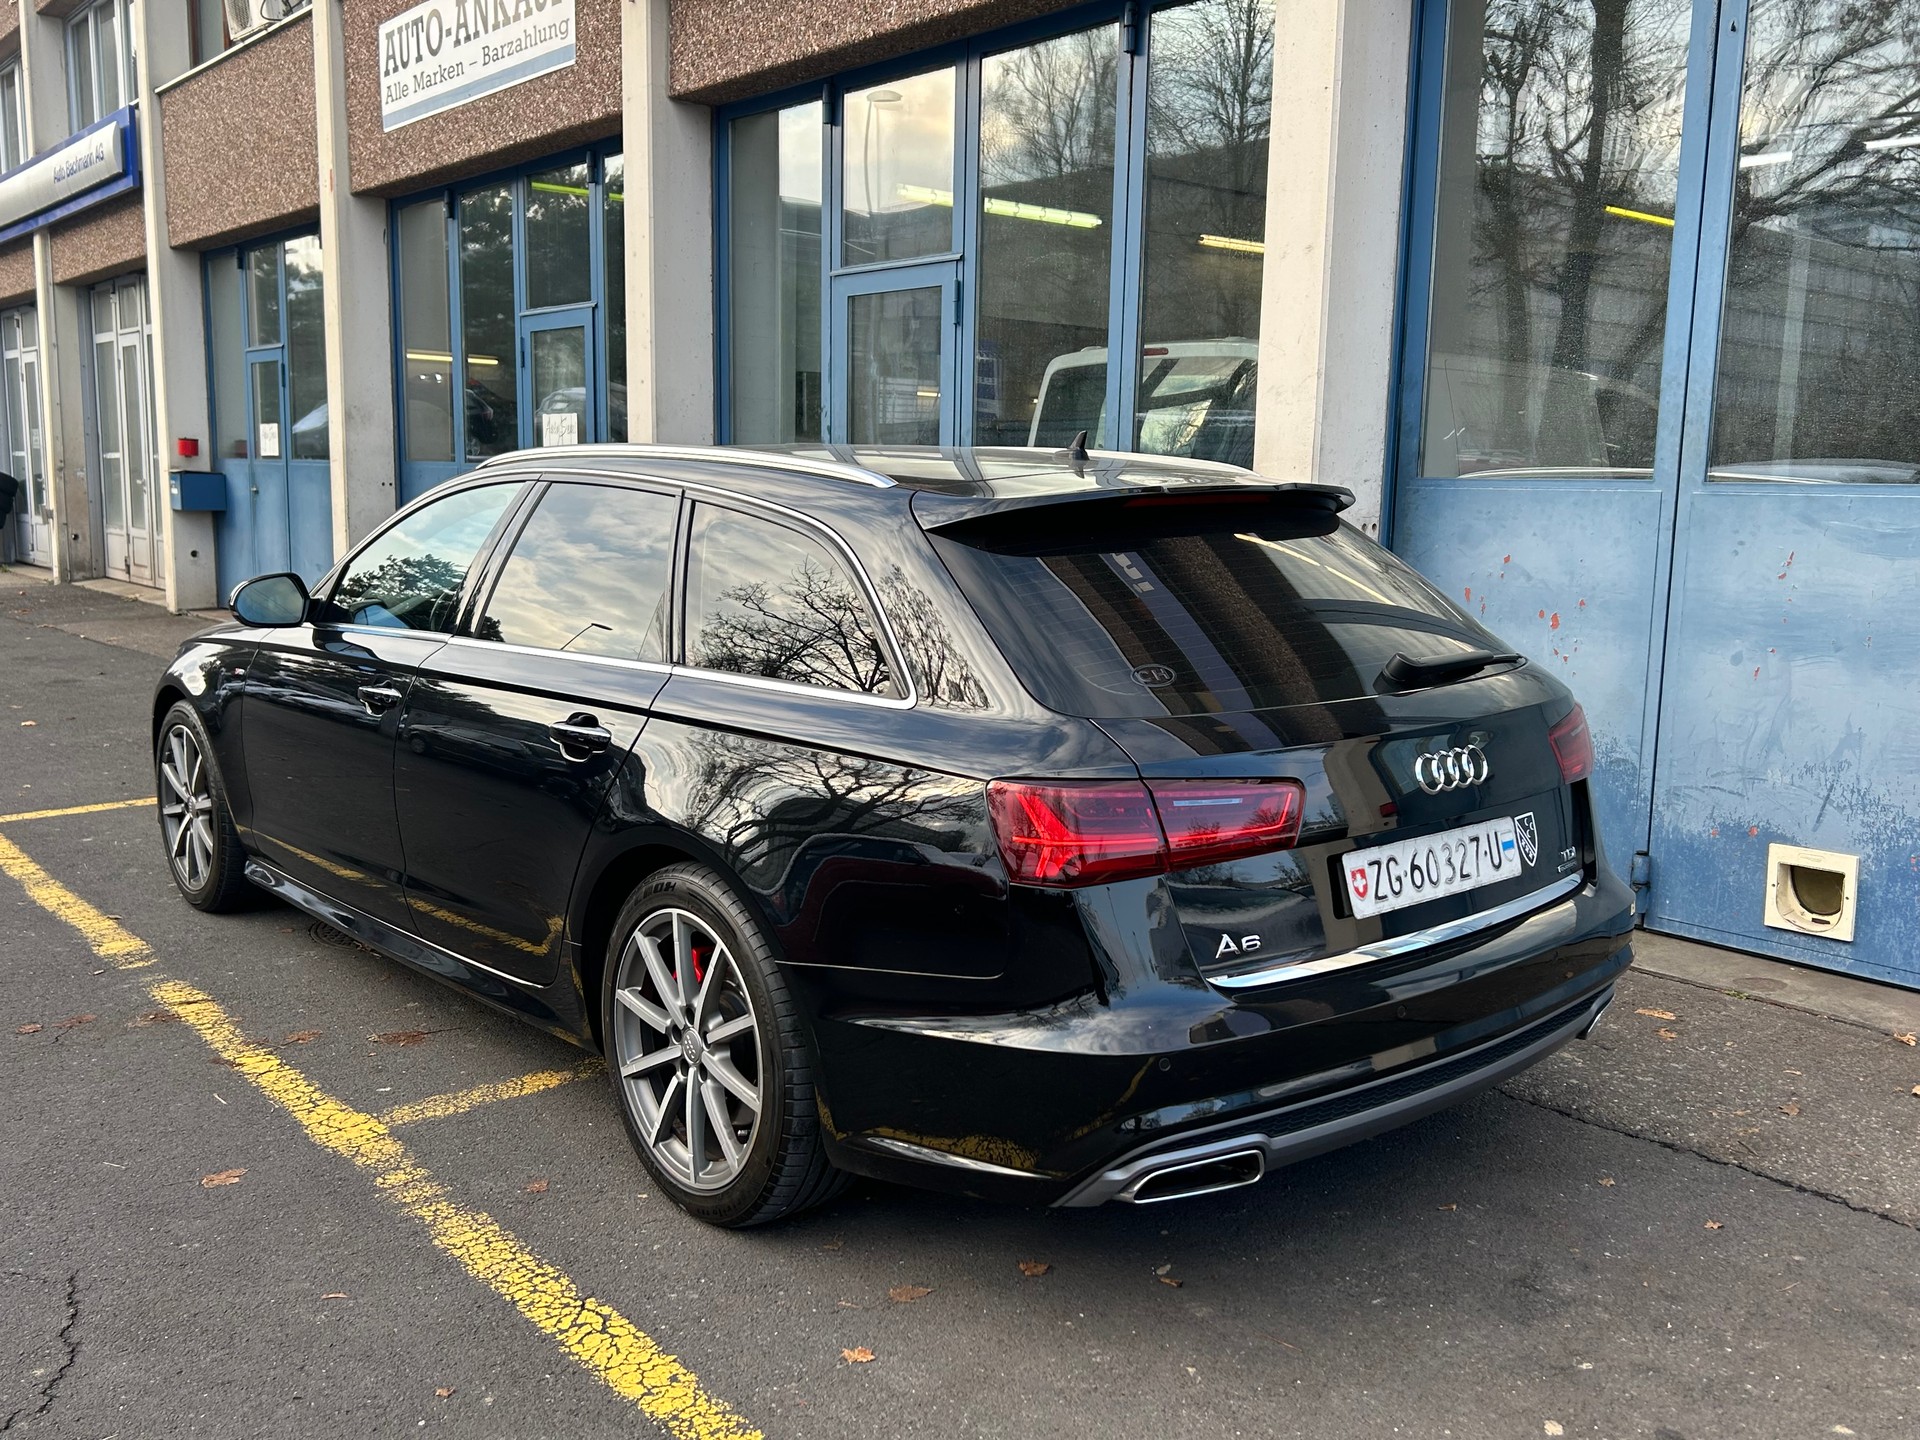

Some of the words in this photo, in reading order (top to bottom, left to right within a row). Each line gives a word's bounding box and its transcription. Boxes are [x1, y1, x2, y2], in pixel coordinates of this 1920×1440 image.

[384, 0, 562, 77] AUTO-ANK
[385, 82, 409, 105] Alle
[413, 61, 464, 94] Marken
[482, 18, 570, 67] Barzahlung
[54, 165, 66, 183] Auto
[95, 142, 105, 163] AG
[1138, 668, 1171, 682] CH
[1215, 933, 1262, 959] A6
